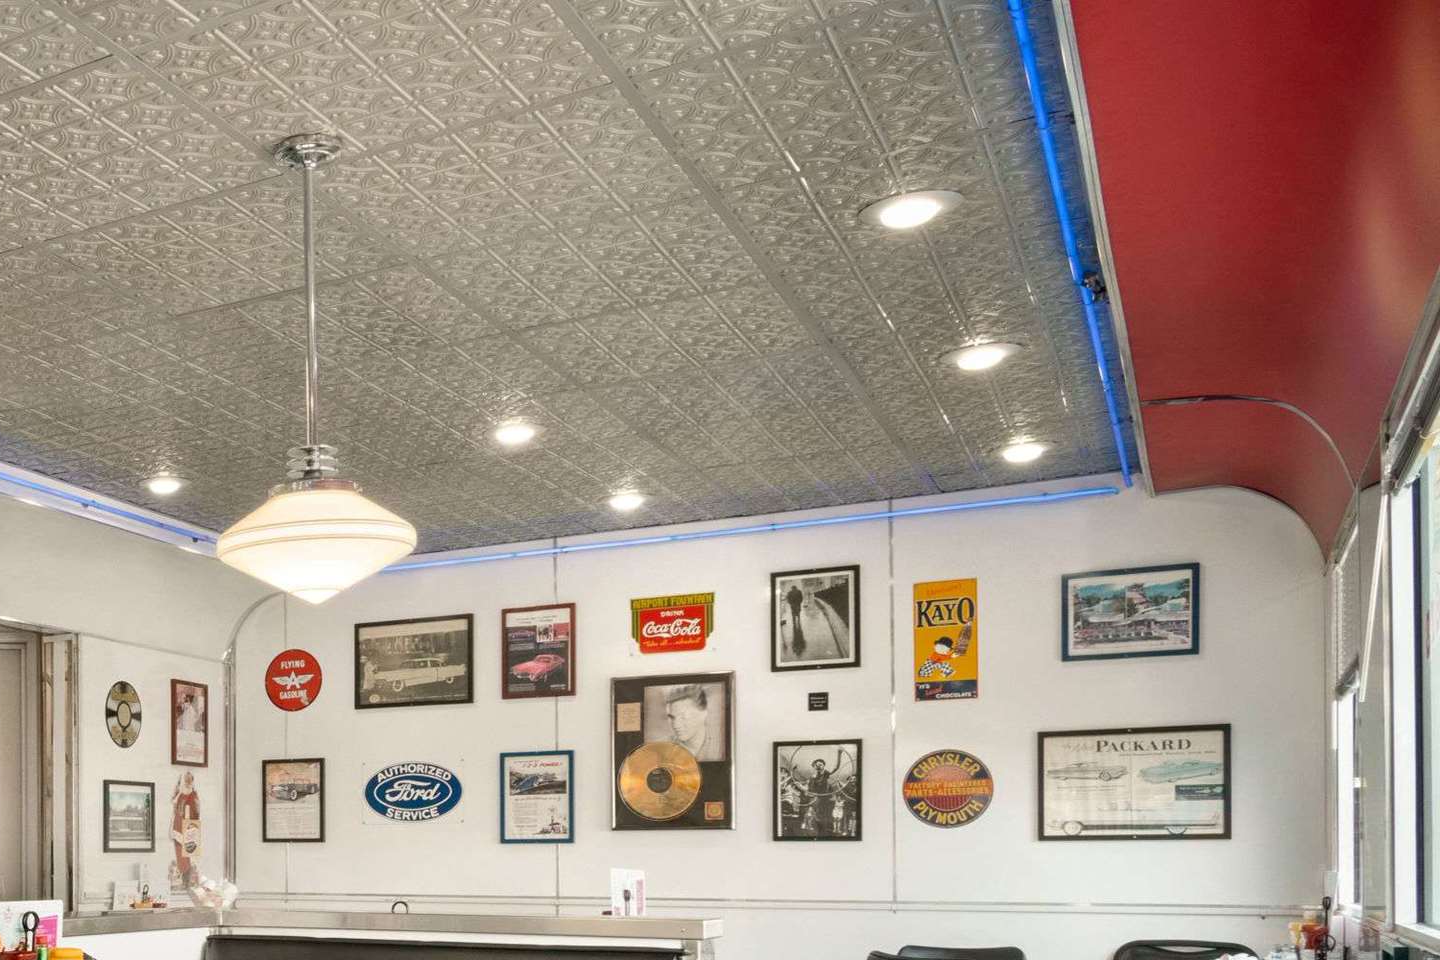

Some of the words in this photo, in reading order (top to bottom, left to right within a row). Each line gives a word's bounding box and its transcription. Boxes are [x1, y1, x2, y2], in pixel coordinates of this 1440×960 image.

[915, 597, 975, 628] KAYO
[642, 617, 703, 638] Coca-Cola
[280, 659, 306, 670] FLYING
[279, 689, 307, 700] GASOLINE
[1095, 738, 1192, 753] PACKARD
[377, 763, 452, 783] AUTHORIZED
[913, 752, 981, 779] CHRYSLER
[385, 779, 441, 803] Ford
[385, 807, 440, 821] SERVICE
[913, 799, 984, 825] PLYMOUTH
